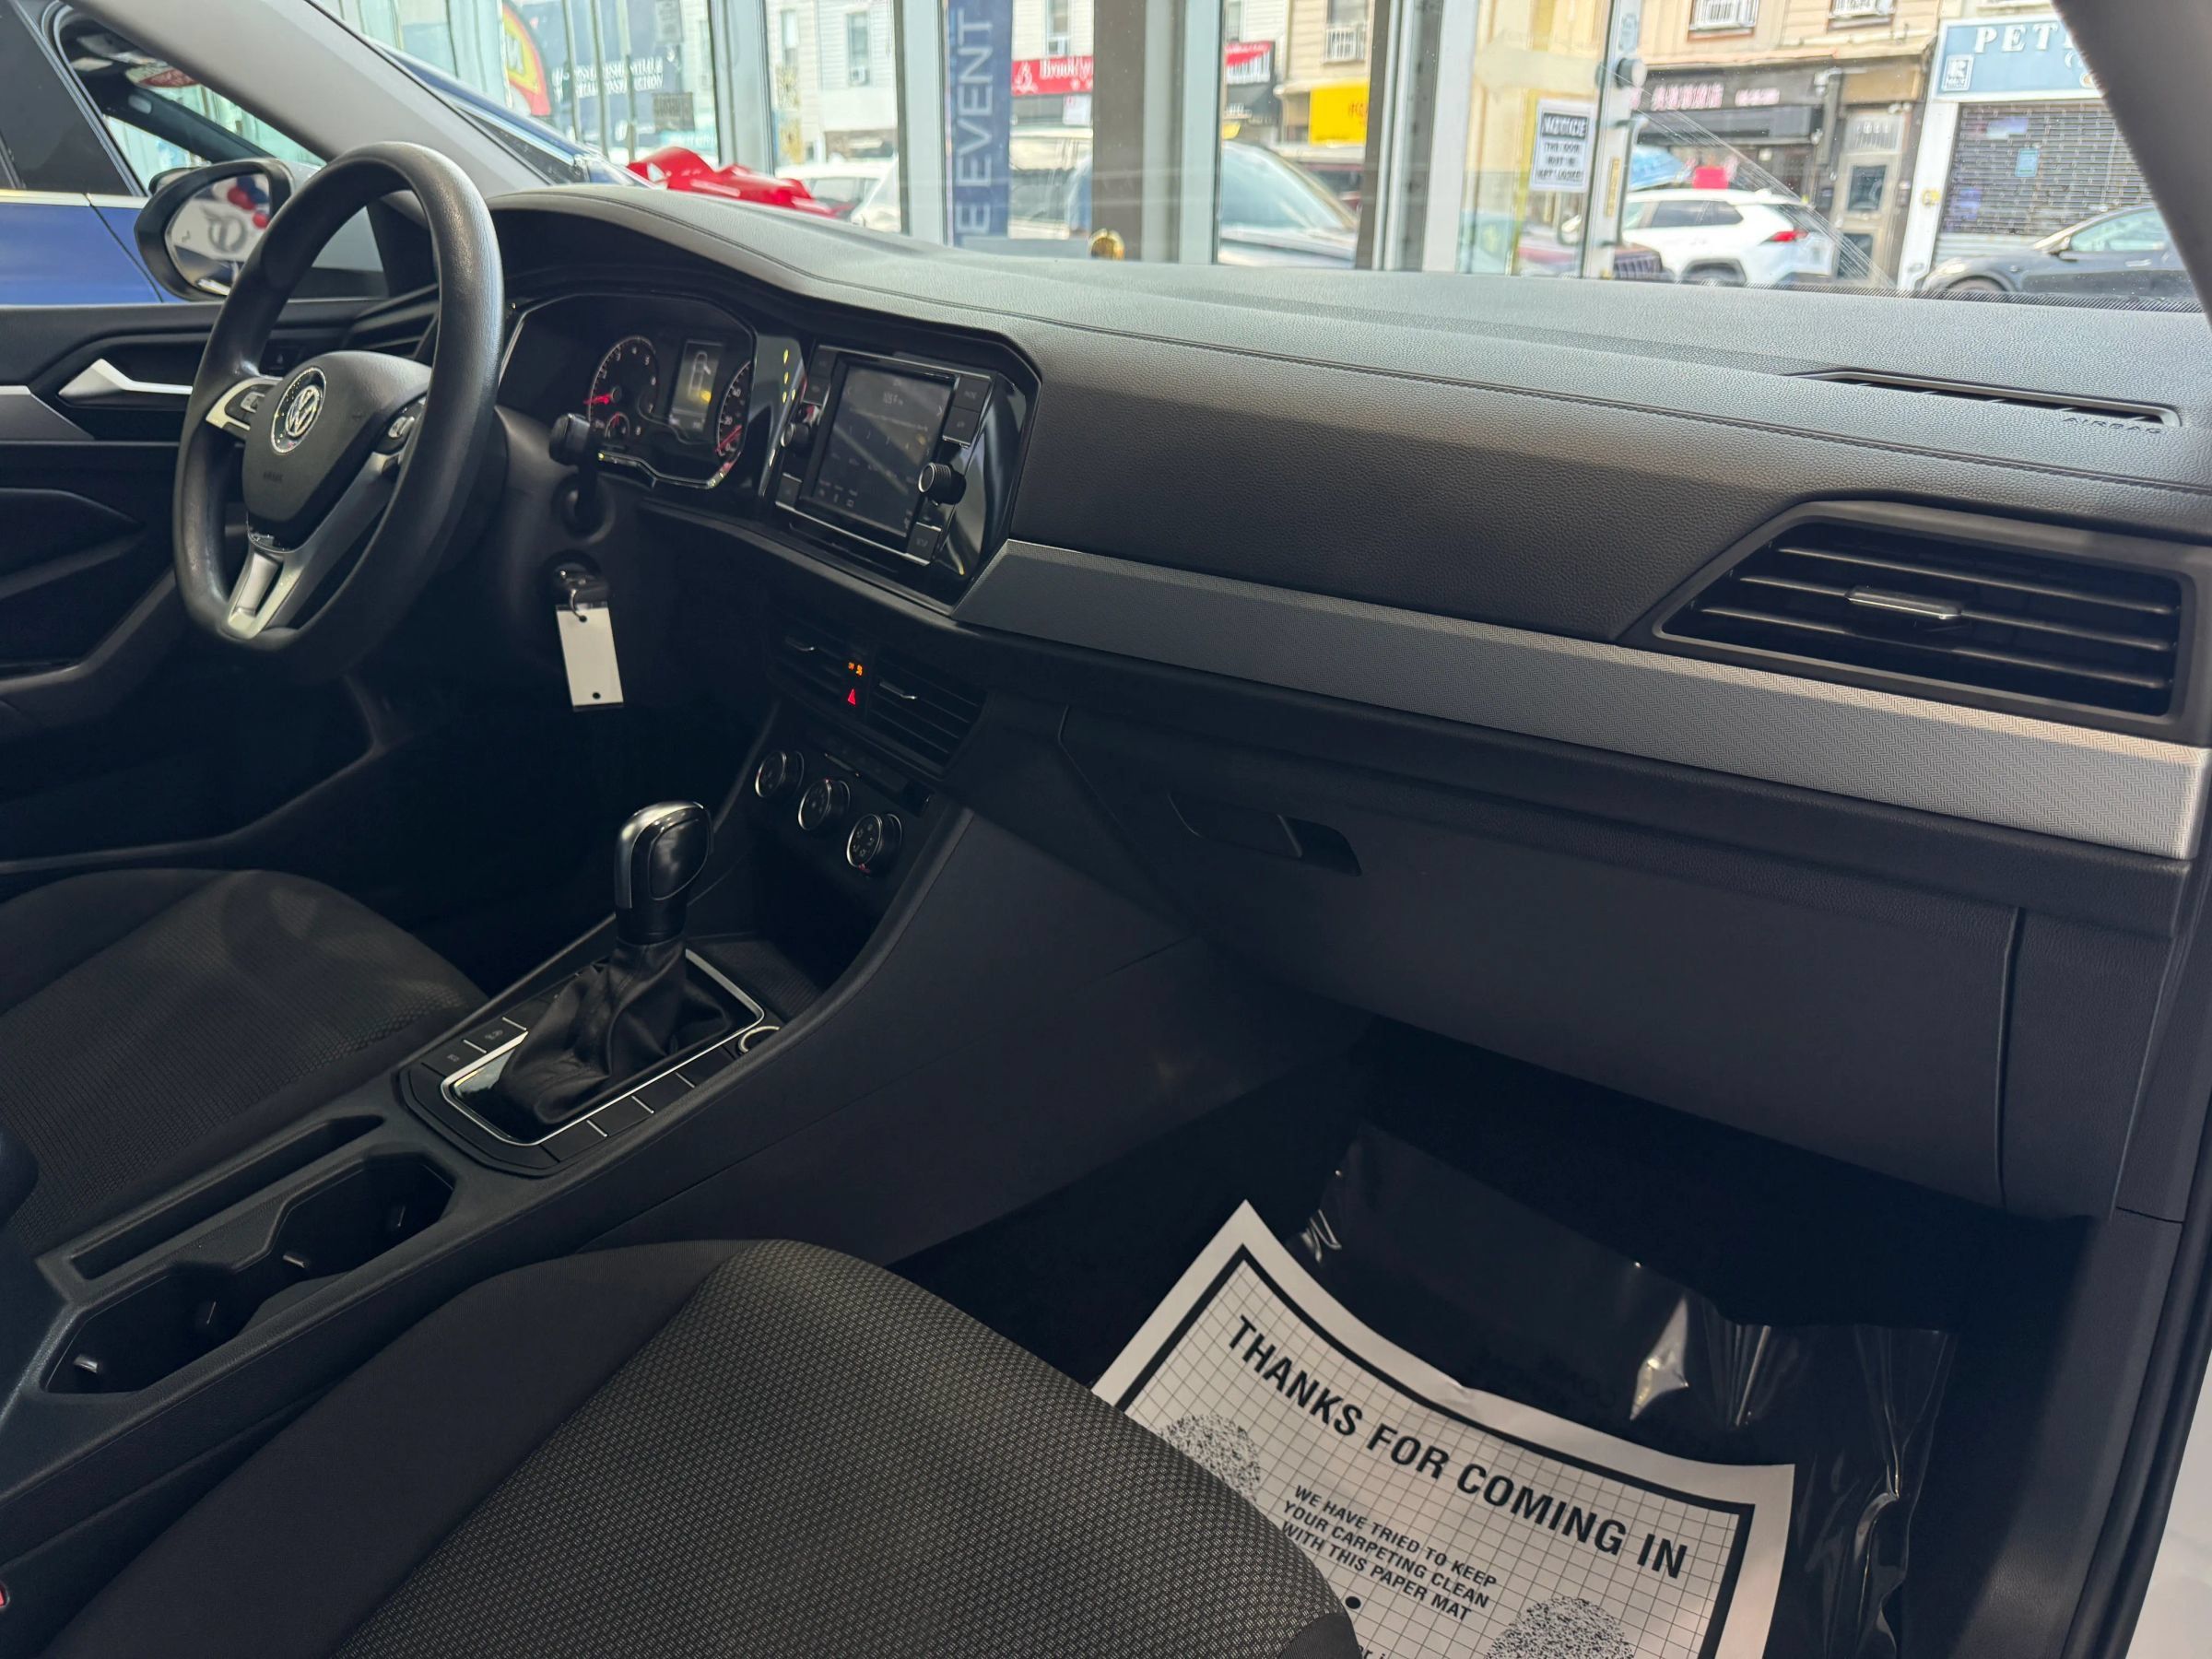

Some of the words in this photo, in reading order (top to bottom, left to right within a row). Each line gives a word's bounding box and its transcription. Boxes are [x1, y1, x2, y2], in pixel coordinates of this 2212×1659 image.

[1974, 22, 2075, 53] PET
[957, 8, 993, 187] EVENT
[2063, 418, 2162, 434] AIRBAG
[1229, 1314, 1363, 1436] THANKS
[1366, 1422, 1449, 1480] FOR
[1456, 1463, 1627, 1557] COMING
[1636, 1533, 1688, 1580] IN
[1280, 1521, 1325, 1551] WITH
[1328, 1544, 1368, 1572] THIS
[1370, 1566, 1429, 1601] PAPER
[1430, 1594, 1473, 1621] MAT
[1283, 1500, 1329, 1533] YOUR
[1331, 1525, 1428, 1580] CARPETING
[1430, 1572, 1490, 1608] CLEAN
[1294, 1485, 1322, 1507] WE
[1324, 1500, 1369, 1530] HAVE
[1371, 1522, 1420, 1554] TRIED
[1425, 1546, 1447, 1567] TO
[1451, 1559, 1498, 1588] KEEP
